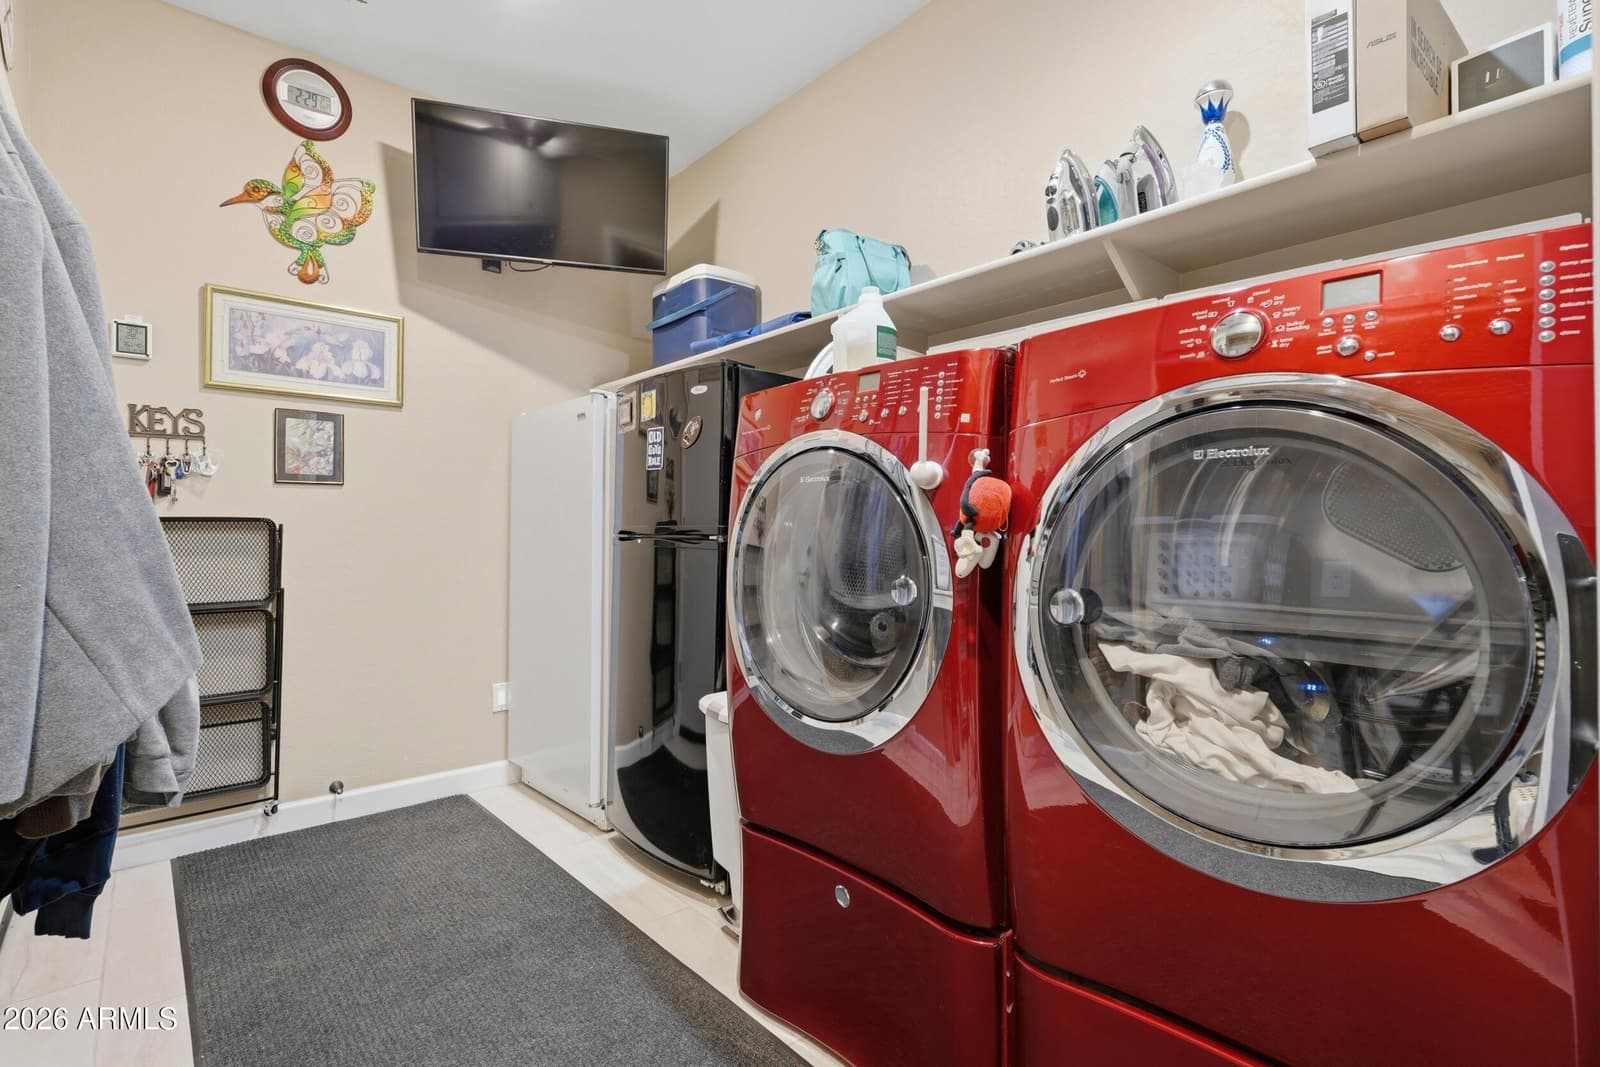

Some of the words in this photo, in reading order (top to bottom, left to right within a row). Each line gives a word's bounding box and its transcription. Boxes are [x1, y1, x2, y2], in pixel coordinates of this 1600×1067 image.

[295, 87, 318, 108] 2:29
[127, 403, 206, 436] KEYS
[648, 431, 662, 443] OLD
[1206, 445, 1271, 459] Electrolux
